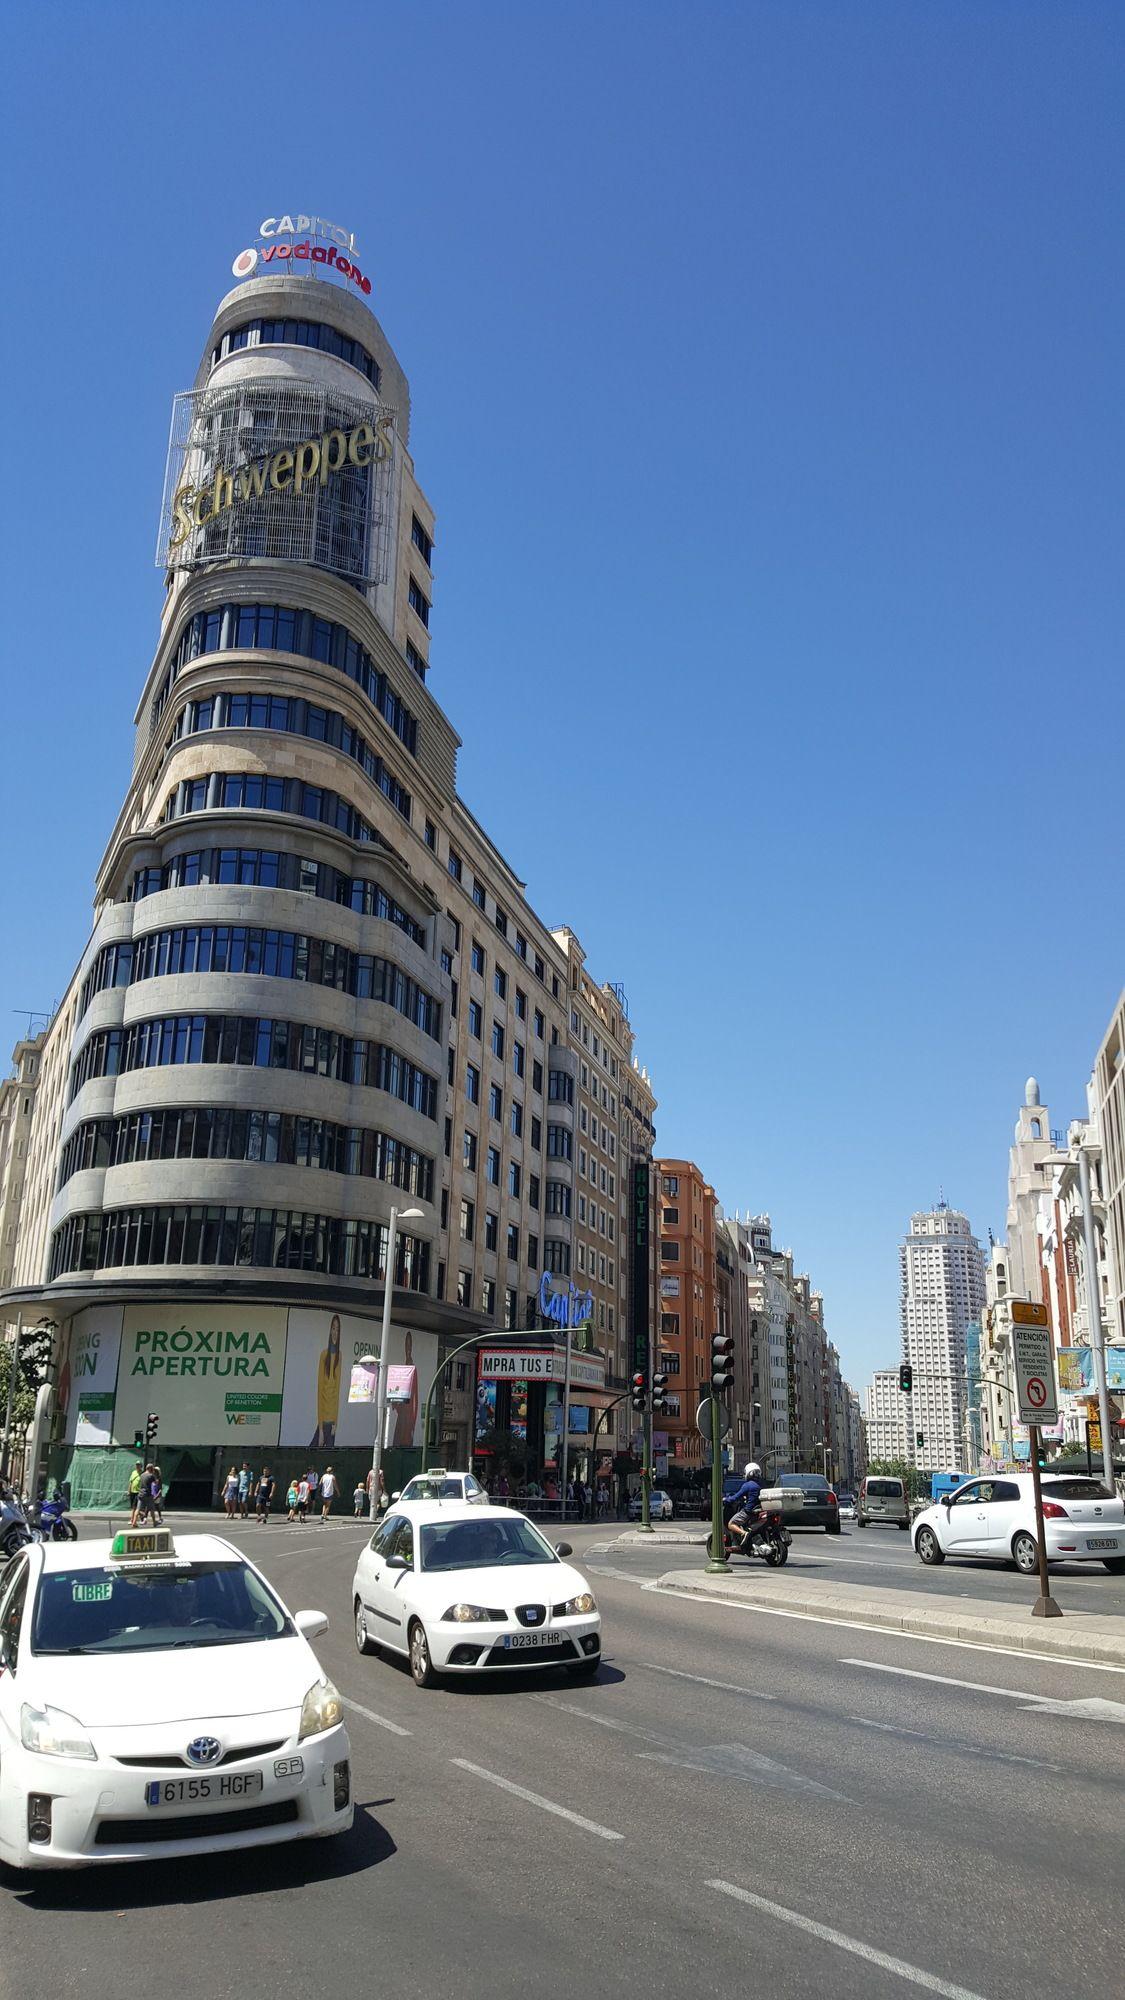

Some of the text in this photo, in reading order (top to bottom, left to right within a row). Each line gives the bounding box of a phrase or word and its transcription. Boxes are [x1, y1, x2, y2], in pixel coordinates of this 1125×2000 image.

[259, 214, 361, 257] CAPITOL
[261, 240, 372, 295] vodafone
[169, 417, 395, 547] Schweppes
[636, 1168, 646, 1246] HOTEL
[135, 1325, 272, 1354] PRÓXIMA
[131, 1356, 270, 1377] APERTURA
[483, 1357, 516, 1373] MPRA
[520, 1358, 542, 1373] TUS
[226, 1413, 246, 1425] WE
[128, 1536, 154, 1552] TAXI
[74, 1584, 110, 1601] LIBRE
[512, 1632, 560, 1647] 0238 FHR
[276, 1760, 301, 1775] SP
[164, 1774, 257, 1801] 6155 HGF
